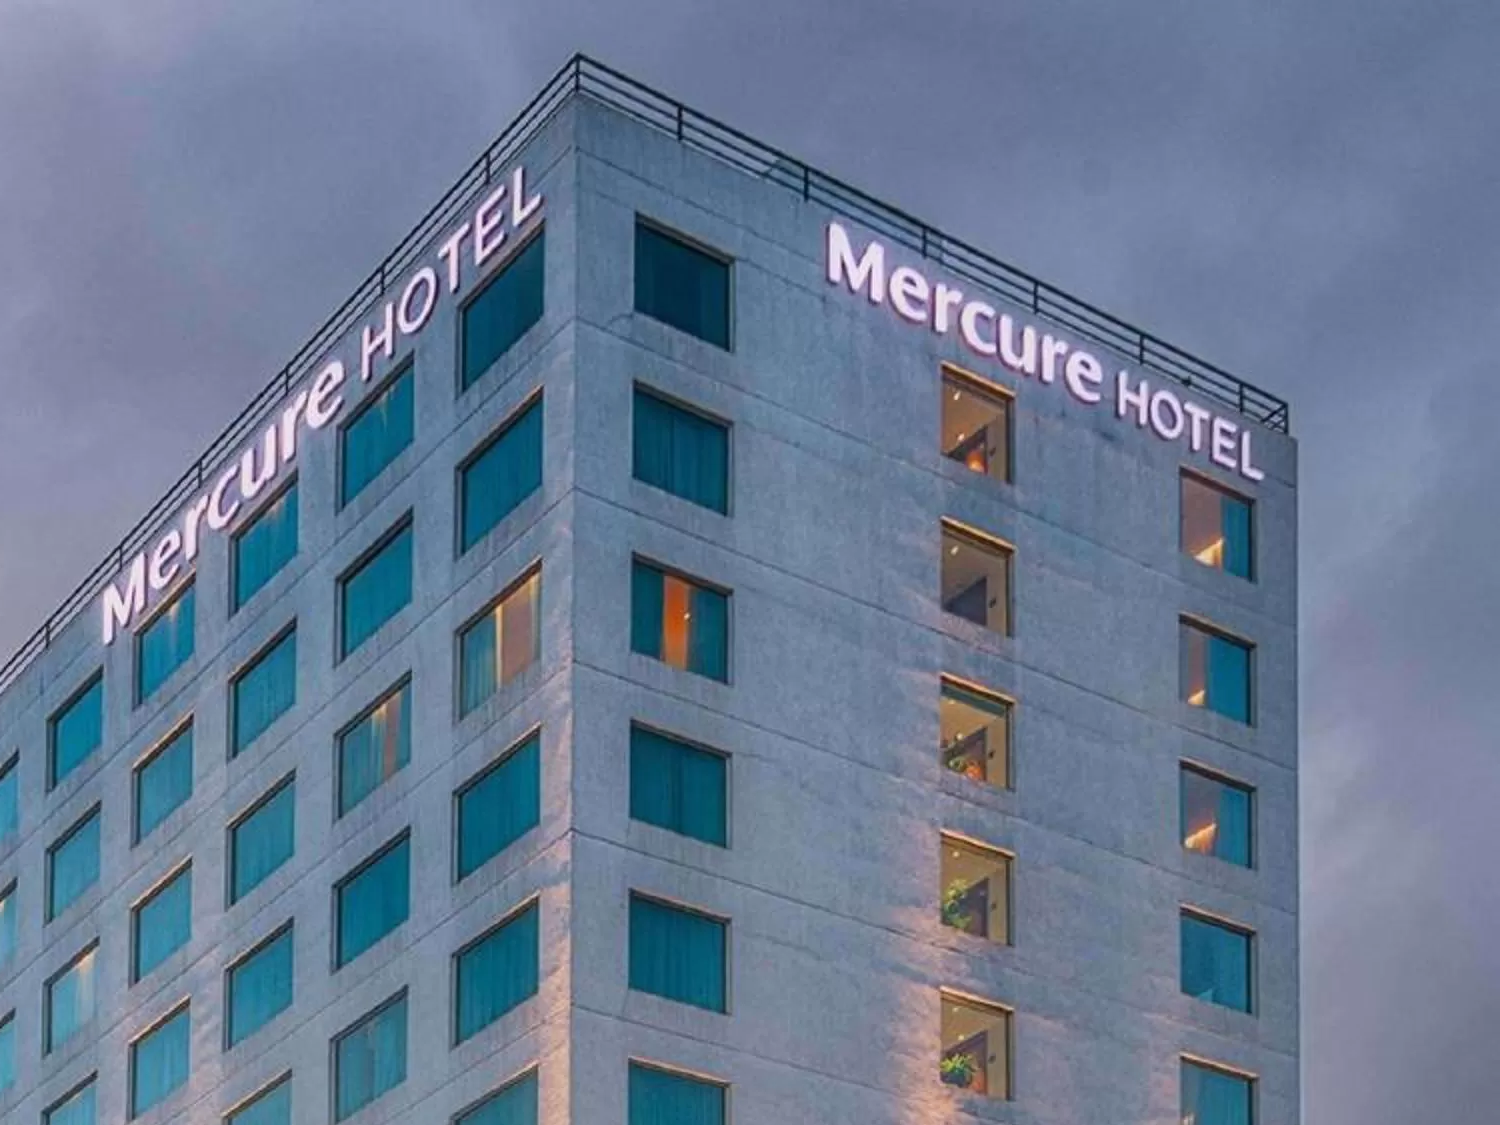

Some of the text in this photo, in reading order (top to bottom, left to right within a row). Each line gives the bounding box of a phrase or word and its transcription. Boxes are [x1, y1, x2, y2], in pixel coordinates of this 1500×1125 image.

[102, 166, 542, 646] Mercure HOTEL
[826, 222, 1265, 482] Mercure HOTEL
